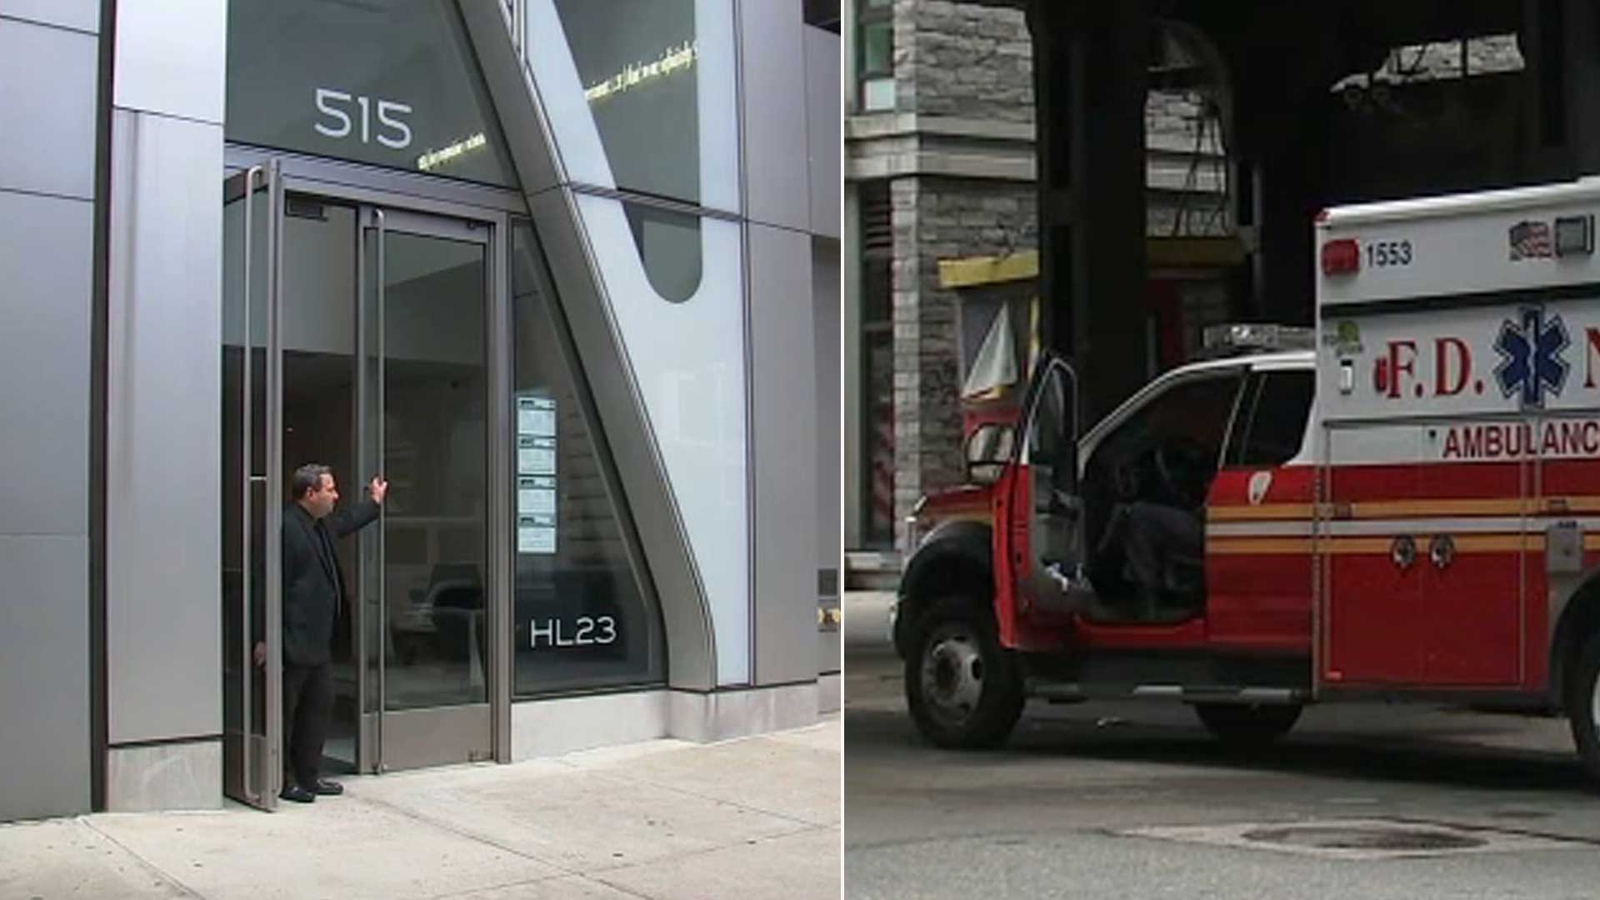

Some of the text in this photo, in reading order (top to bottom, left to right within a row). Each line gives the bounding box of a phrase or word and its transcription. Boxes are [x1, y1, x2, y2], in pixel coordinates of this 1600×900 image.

[314, 88, 412, 149] 515
[1367, 240, 1413, 267] 1553
[530, 616, 617, 648] HL23
